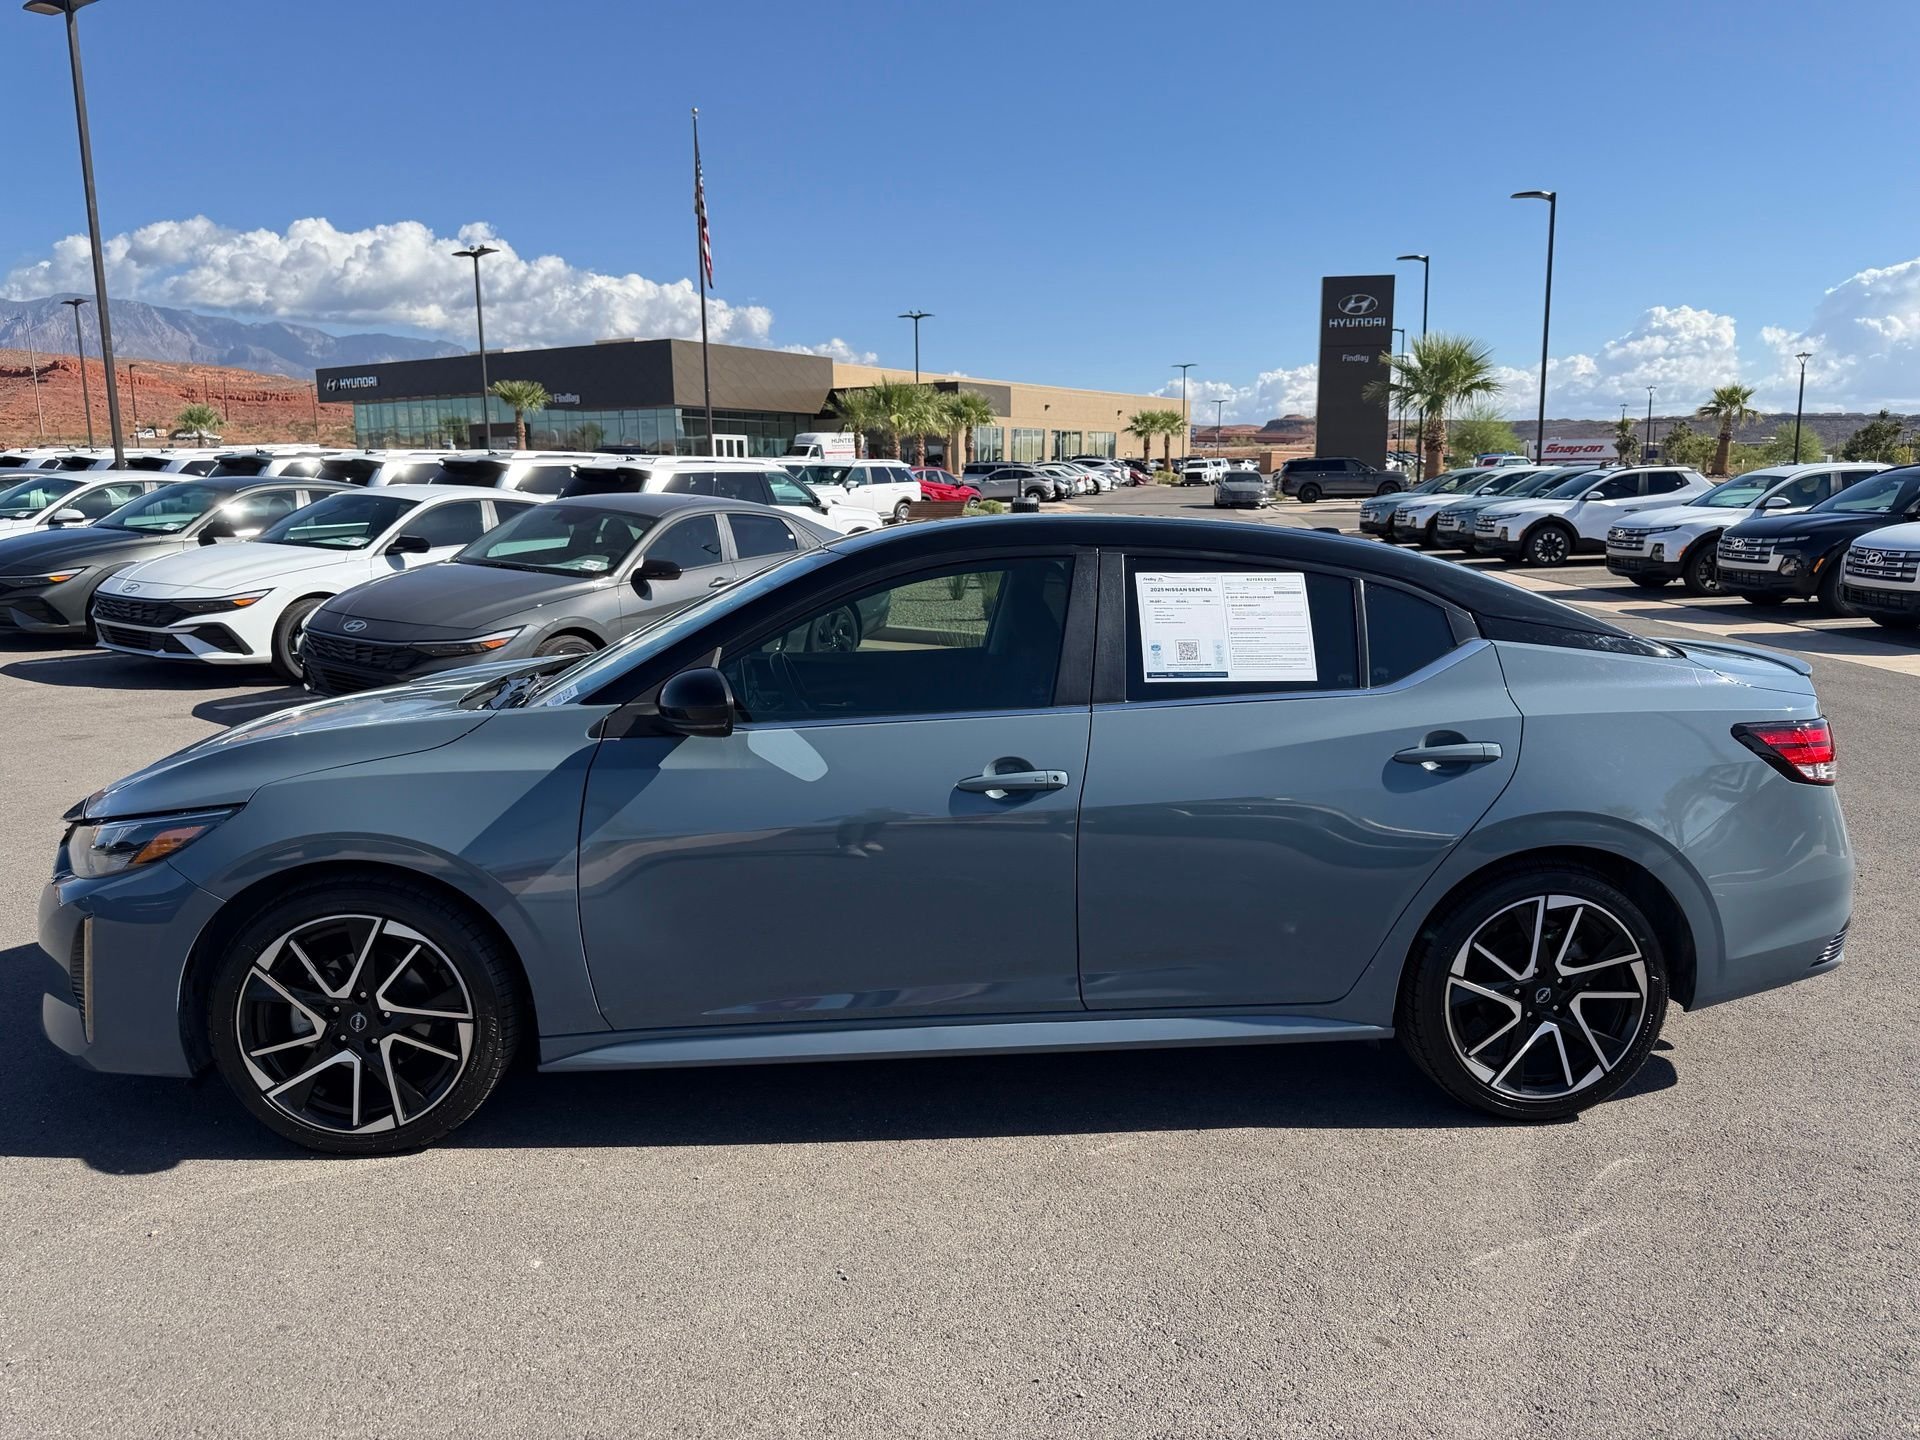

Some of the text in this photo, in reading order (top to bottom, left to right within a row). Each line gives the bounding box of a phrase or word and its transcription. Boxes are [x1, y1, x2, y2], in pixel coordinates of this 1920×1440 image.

[1329, 317, 1386, 328] HYUNDAI
[1342, 354, 1369, 363] Findlay
[340, 376, 377, 389] HYUNDAI
[553, 393, 581, 404] Findlay
[1544, 443, 1604, 455] Snap-on
